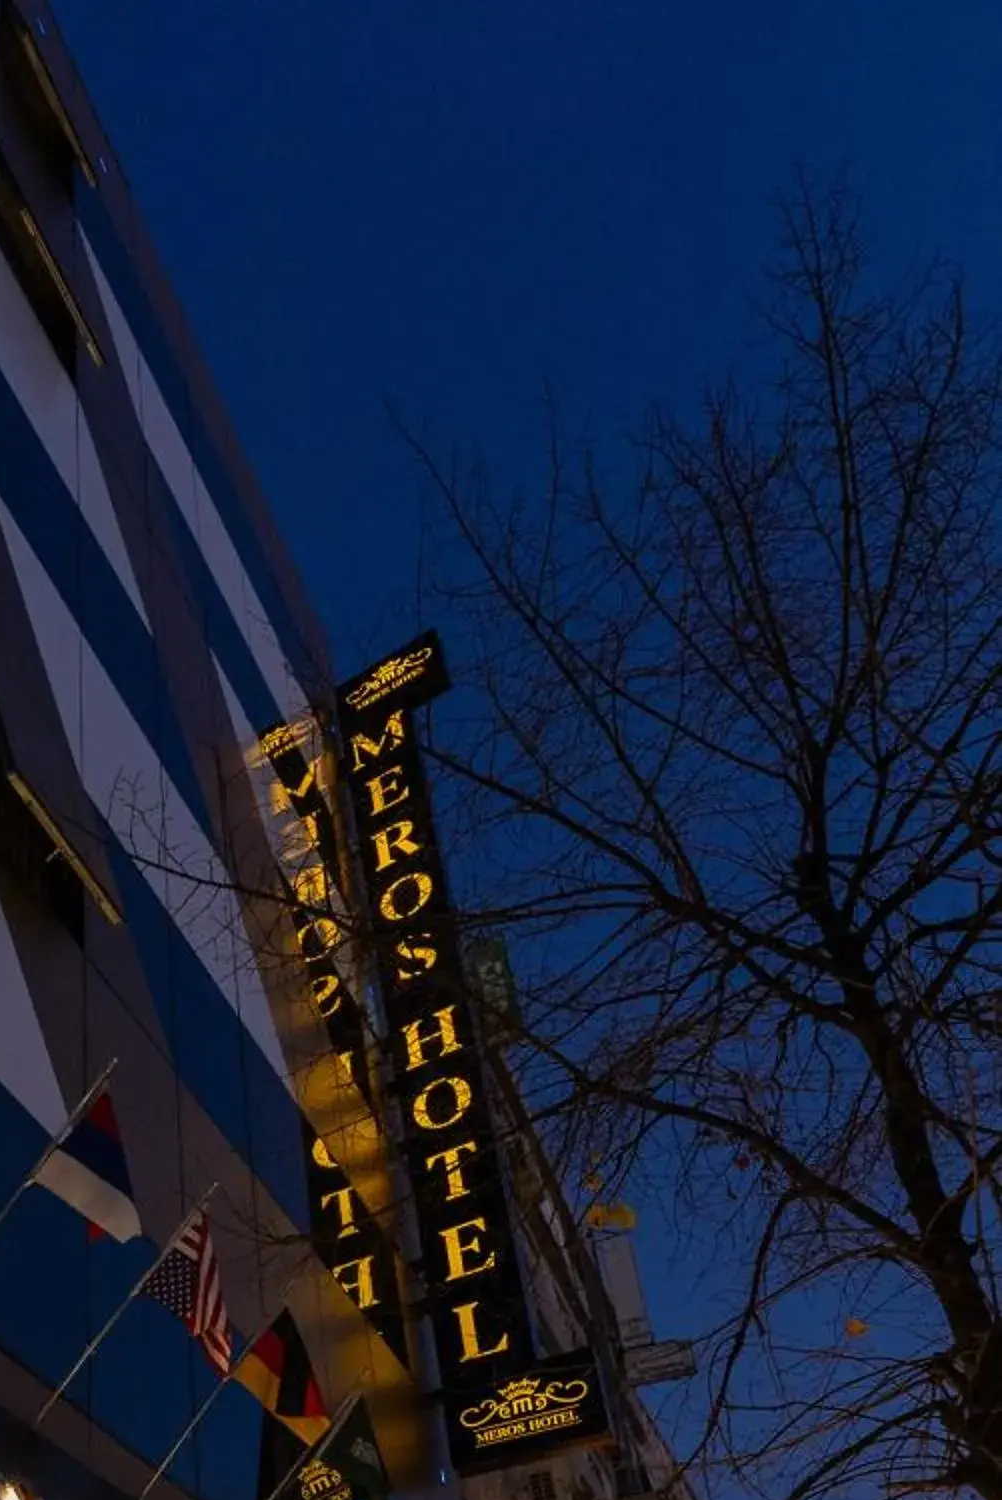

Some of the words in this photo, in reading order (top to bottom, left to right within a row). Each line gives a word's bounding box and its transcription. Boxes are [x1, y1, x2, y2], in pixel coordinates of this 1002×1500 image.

[350, 708, 438, 982] MEROS
[400, 1003, 508, 1364] HOTEL
[475, 1422, 527, 1445] MEROS
[528, 1409, 580, 1432] HOTEL
